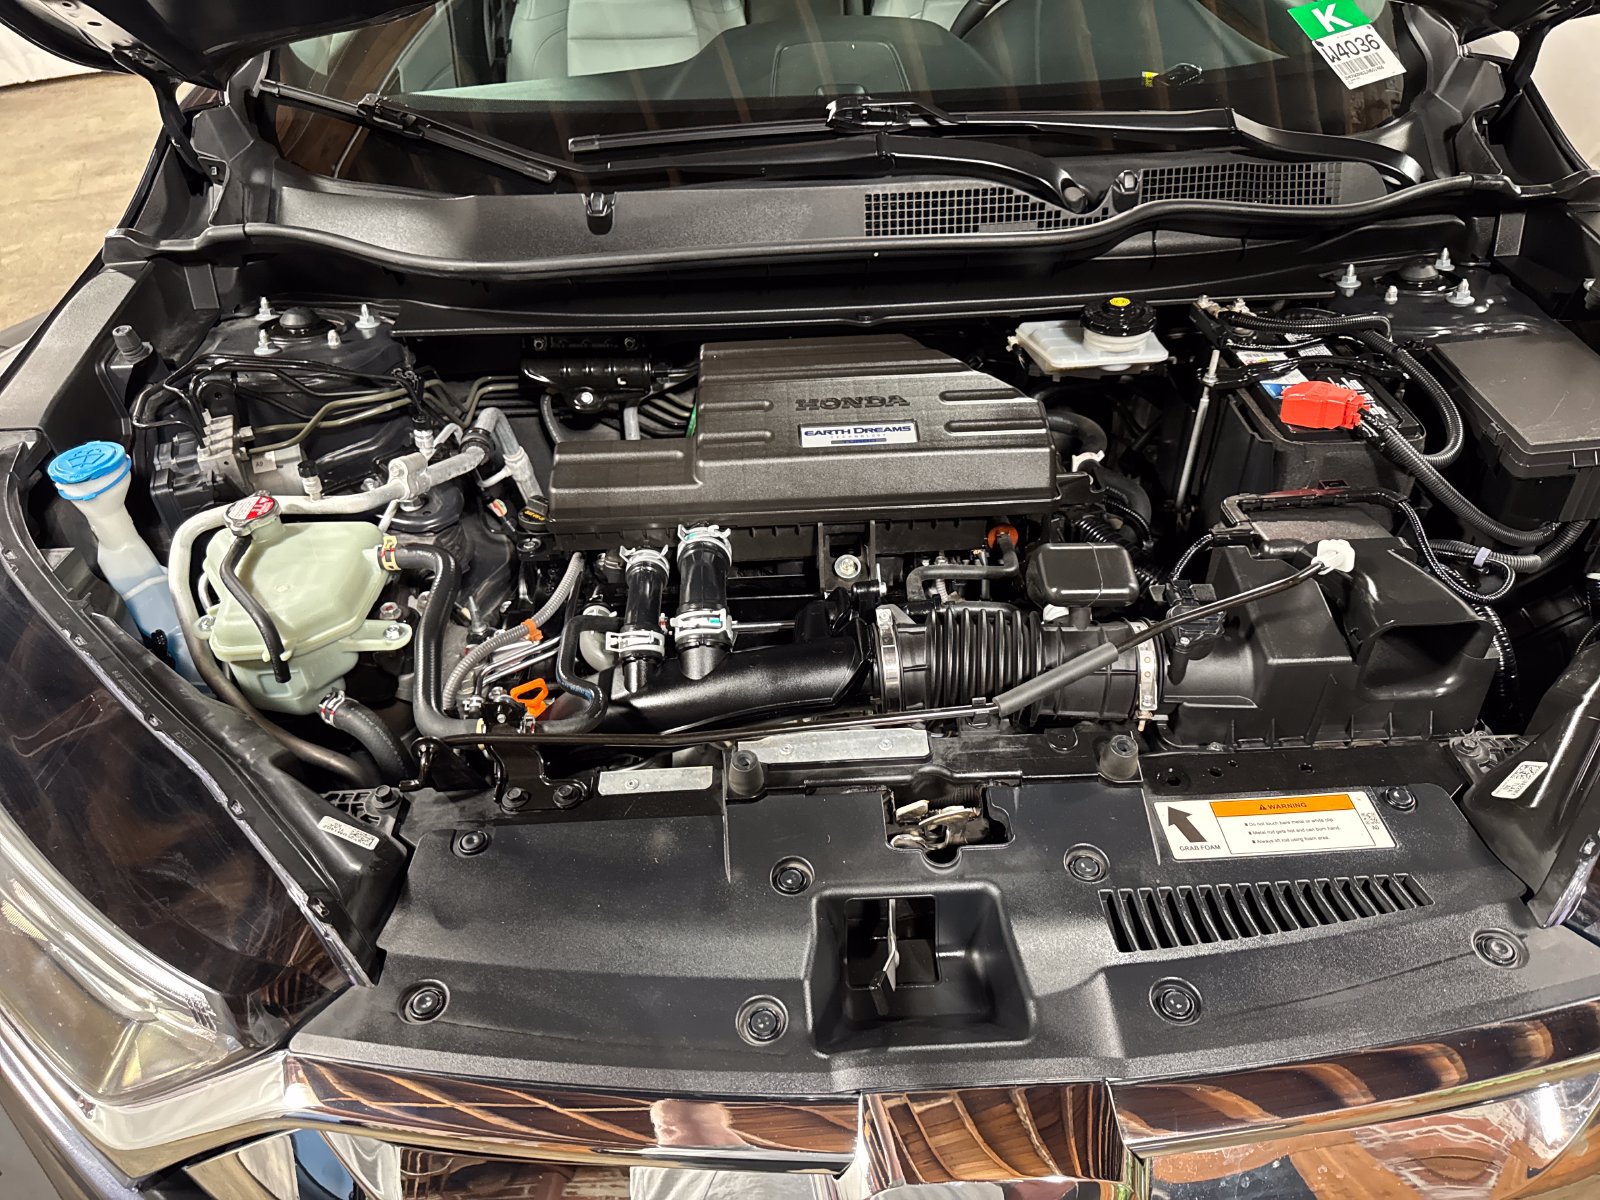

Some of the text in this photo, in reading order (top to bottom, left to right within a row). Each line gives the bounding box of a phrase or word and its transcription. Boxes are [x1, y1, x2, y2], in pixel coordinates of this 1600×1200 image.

[1311, 3, 1353, 33] K
[1321, 34, 1381, 63] W4036
[795, 394, 911, 411] HONDA
[804, 425, 912, 436] EARTH DREAMS
[1267, 802, 1308, 810] WARNING
